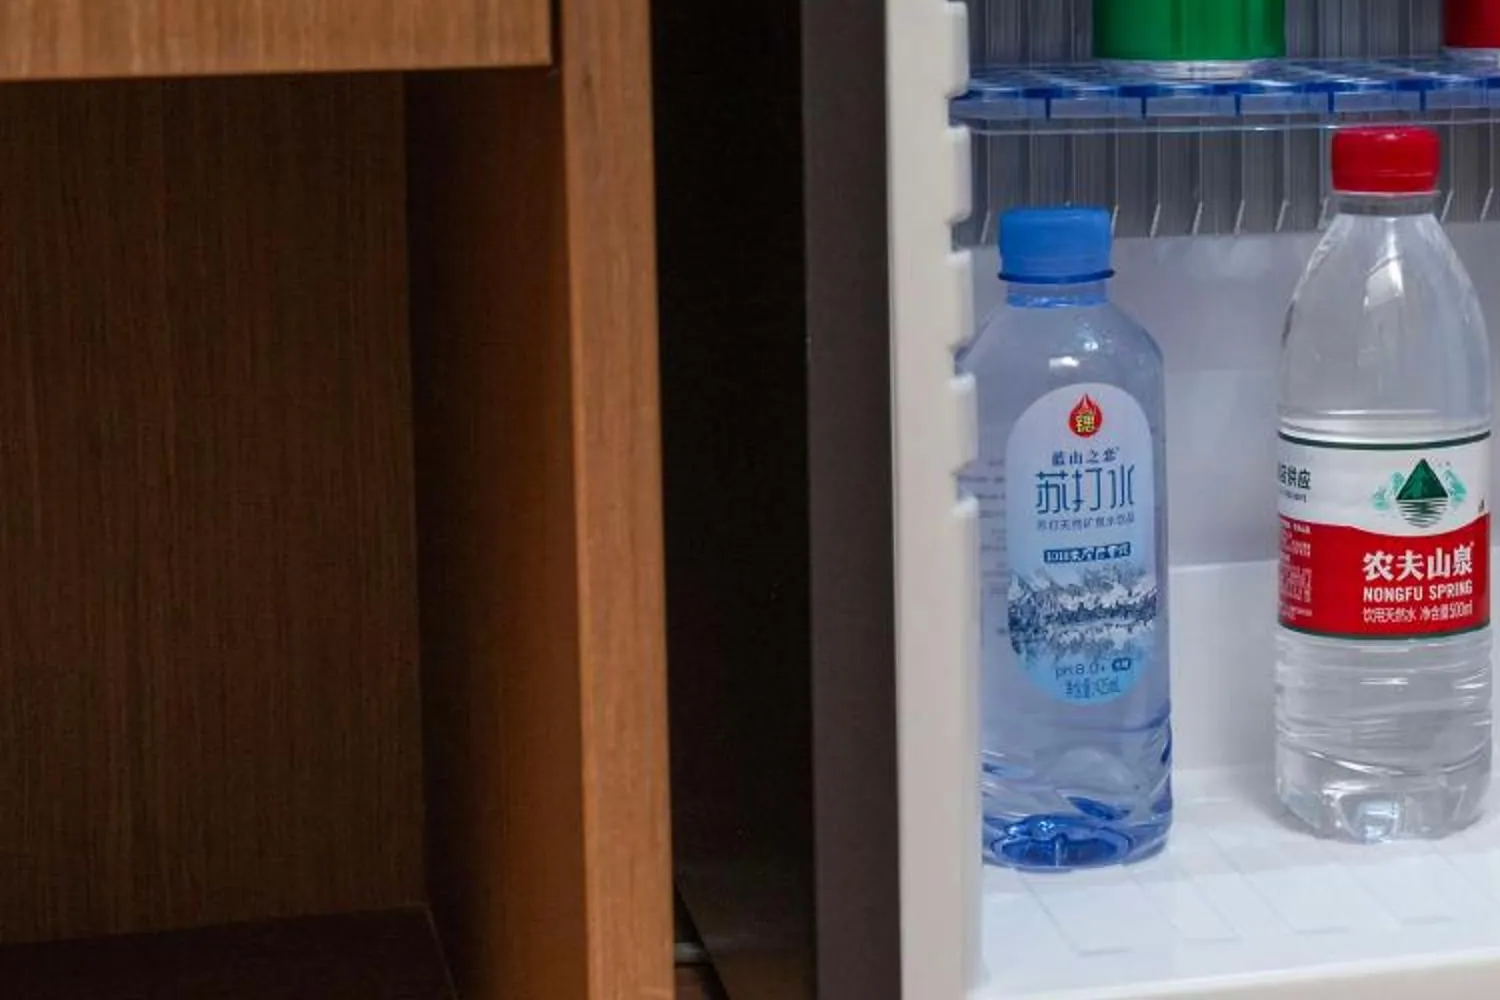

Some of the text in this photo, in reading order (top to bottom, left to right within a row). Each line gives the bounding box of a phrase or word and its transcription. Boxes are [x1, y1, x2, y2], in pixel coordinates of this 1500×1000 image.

[1035, 464, 1135, 514] 苏打水
[1362, 544, 1472, 581] 农夫山泉
[1363, 579, 1473, 602] NONGFU SPRING
[1362, 606, 1417, 623] 饮用天然水
